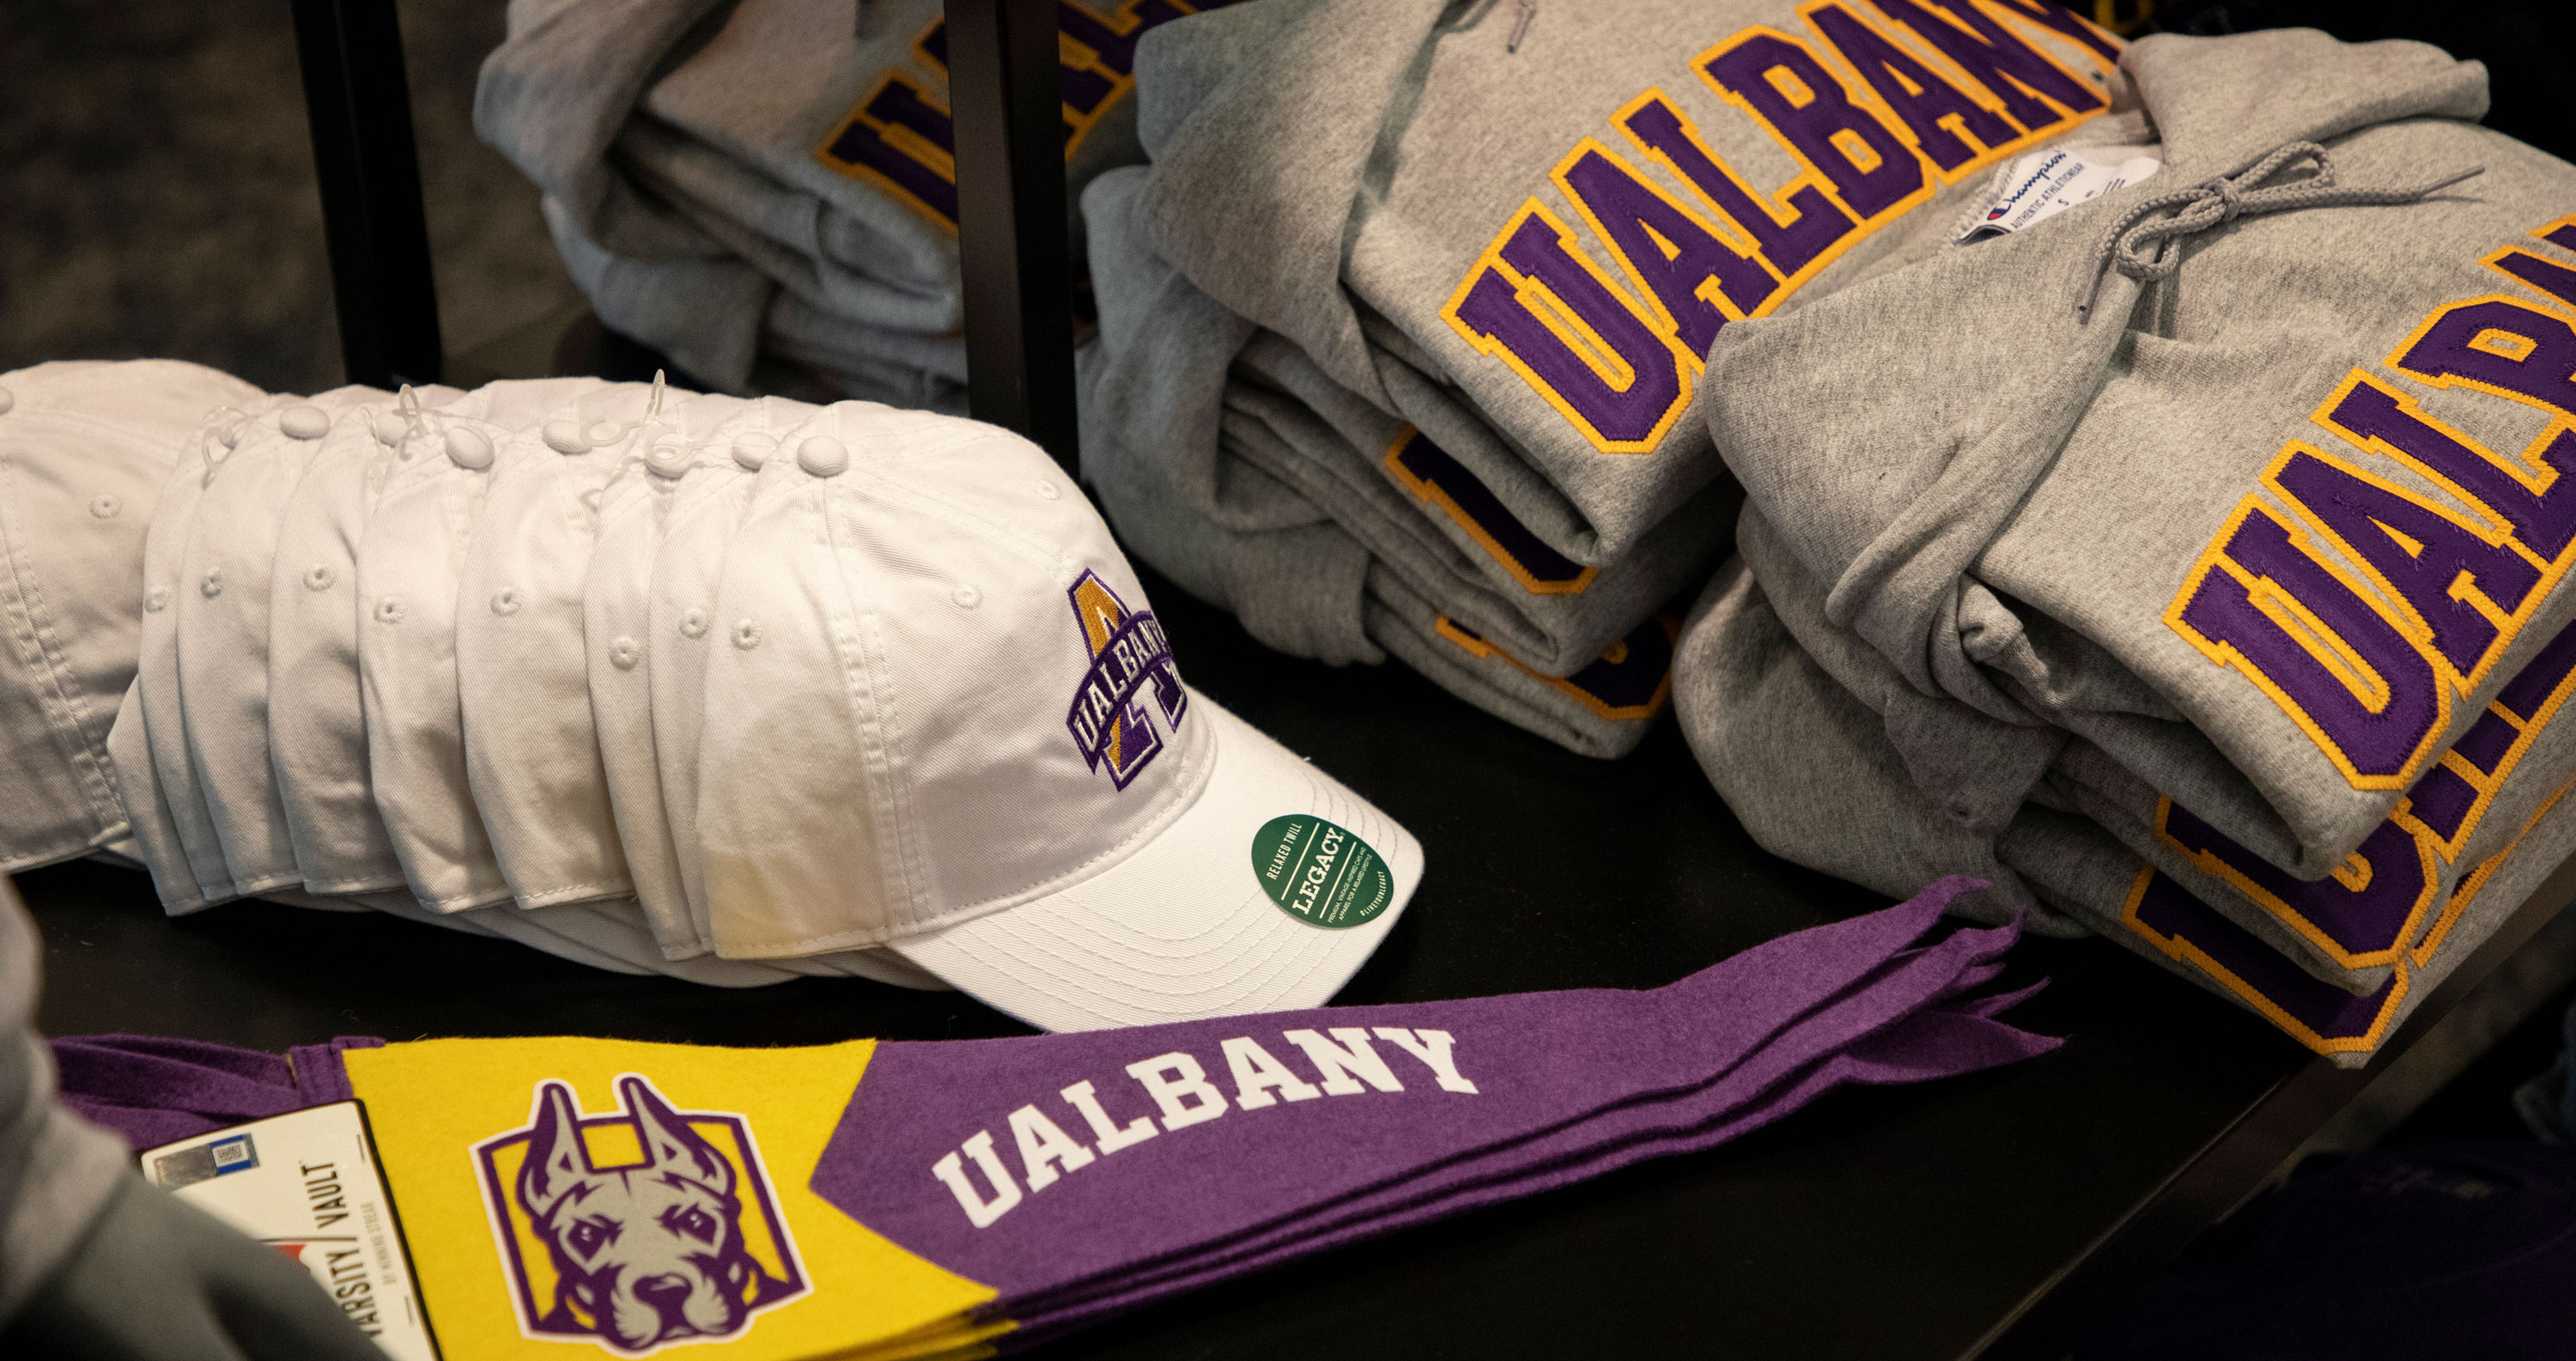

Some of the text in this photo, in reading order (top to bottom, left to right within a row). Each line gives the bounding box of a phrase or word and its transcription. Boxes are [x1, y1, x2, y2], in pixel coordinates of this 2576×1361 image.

[1987, 149, 2066, 220] Champion
[2011, 198, 2045, 228] AUTHENTIC
[2041, 162, 2085, 201] ATHLETICWEAR
[1073, 618, 1170, 753] UALBANY
[1266, 823, 1303, 880] RELAXED TWILL
[1354, 855, 1364, 866] CAPS
[1339, 902, 1352, 921] APPAREL
[1346, 891, 1355, 901] FOR
[1353, 871, 1365, 890] RELAXED
[1361, 854, 1373, 872] LIFESTYLE
[932, 1027, 1479, 1228] UALBANY
[301, 1162, 349, 1230] VAULT
